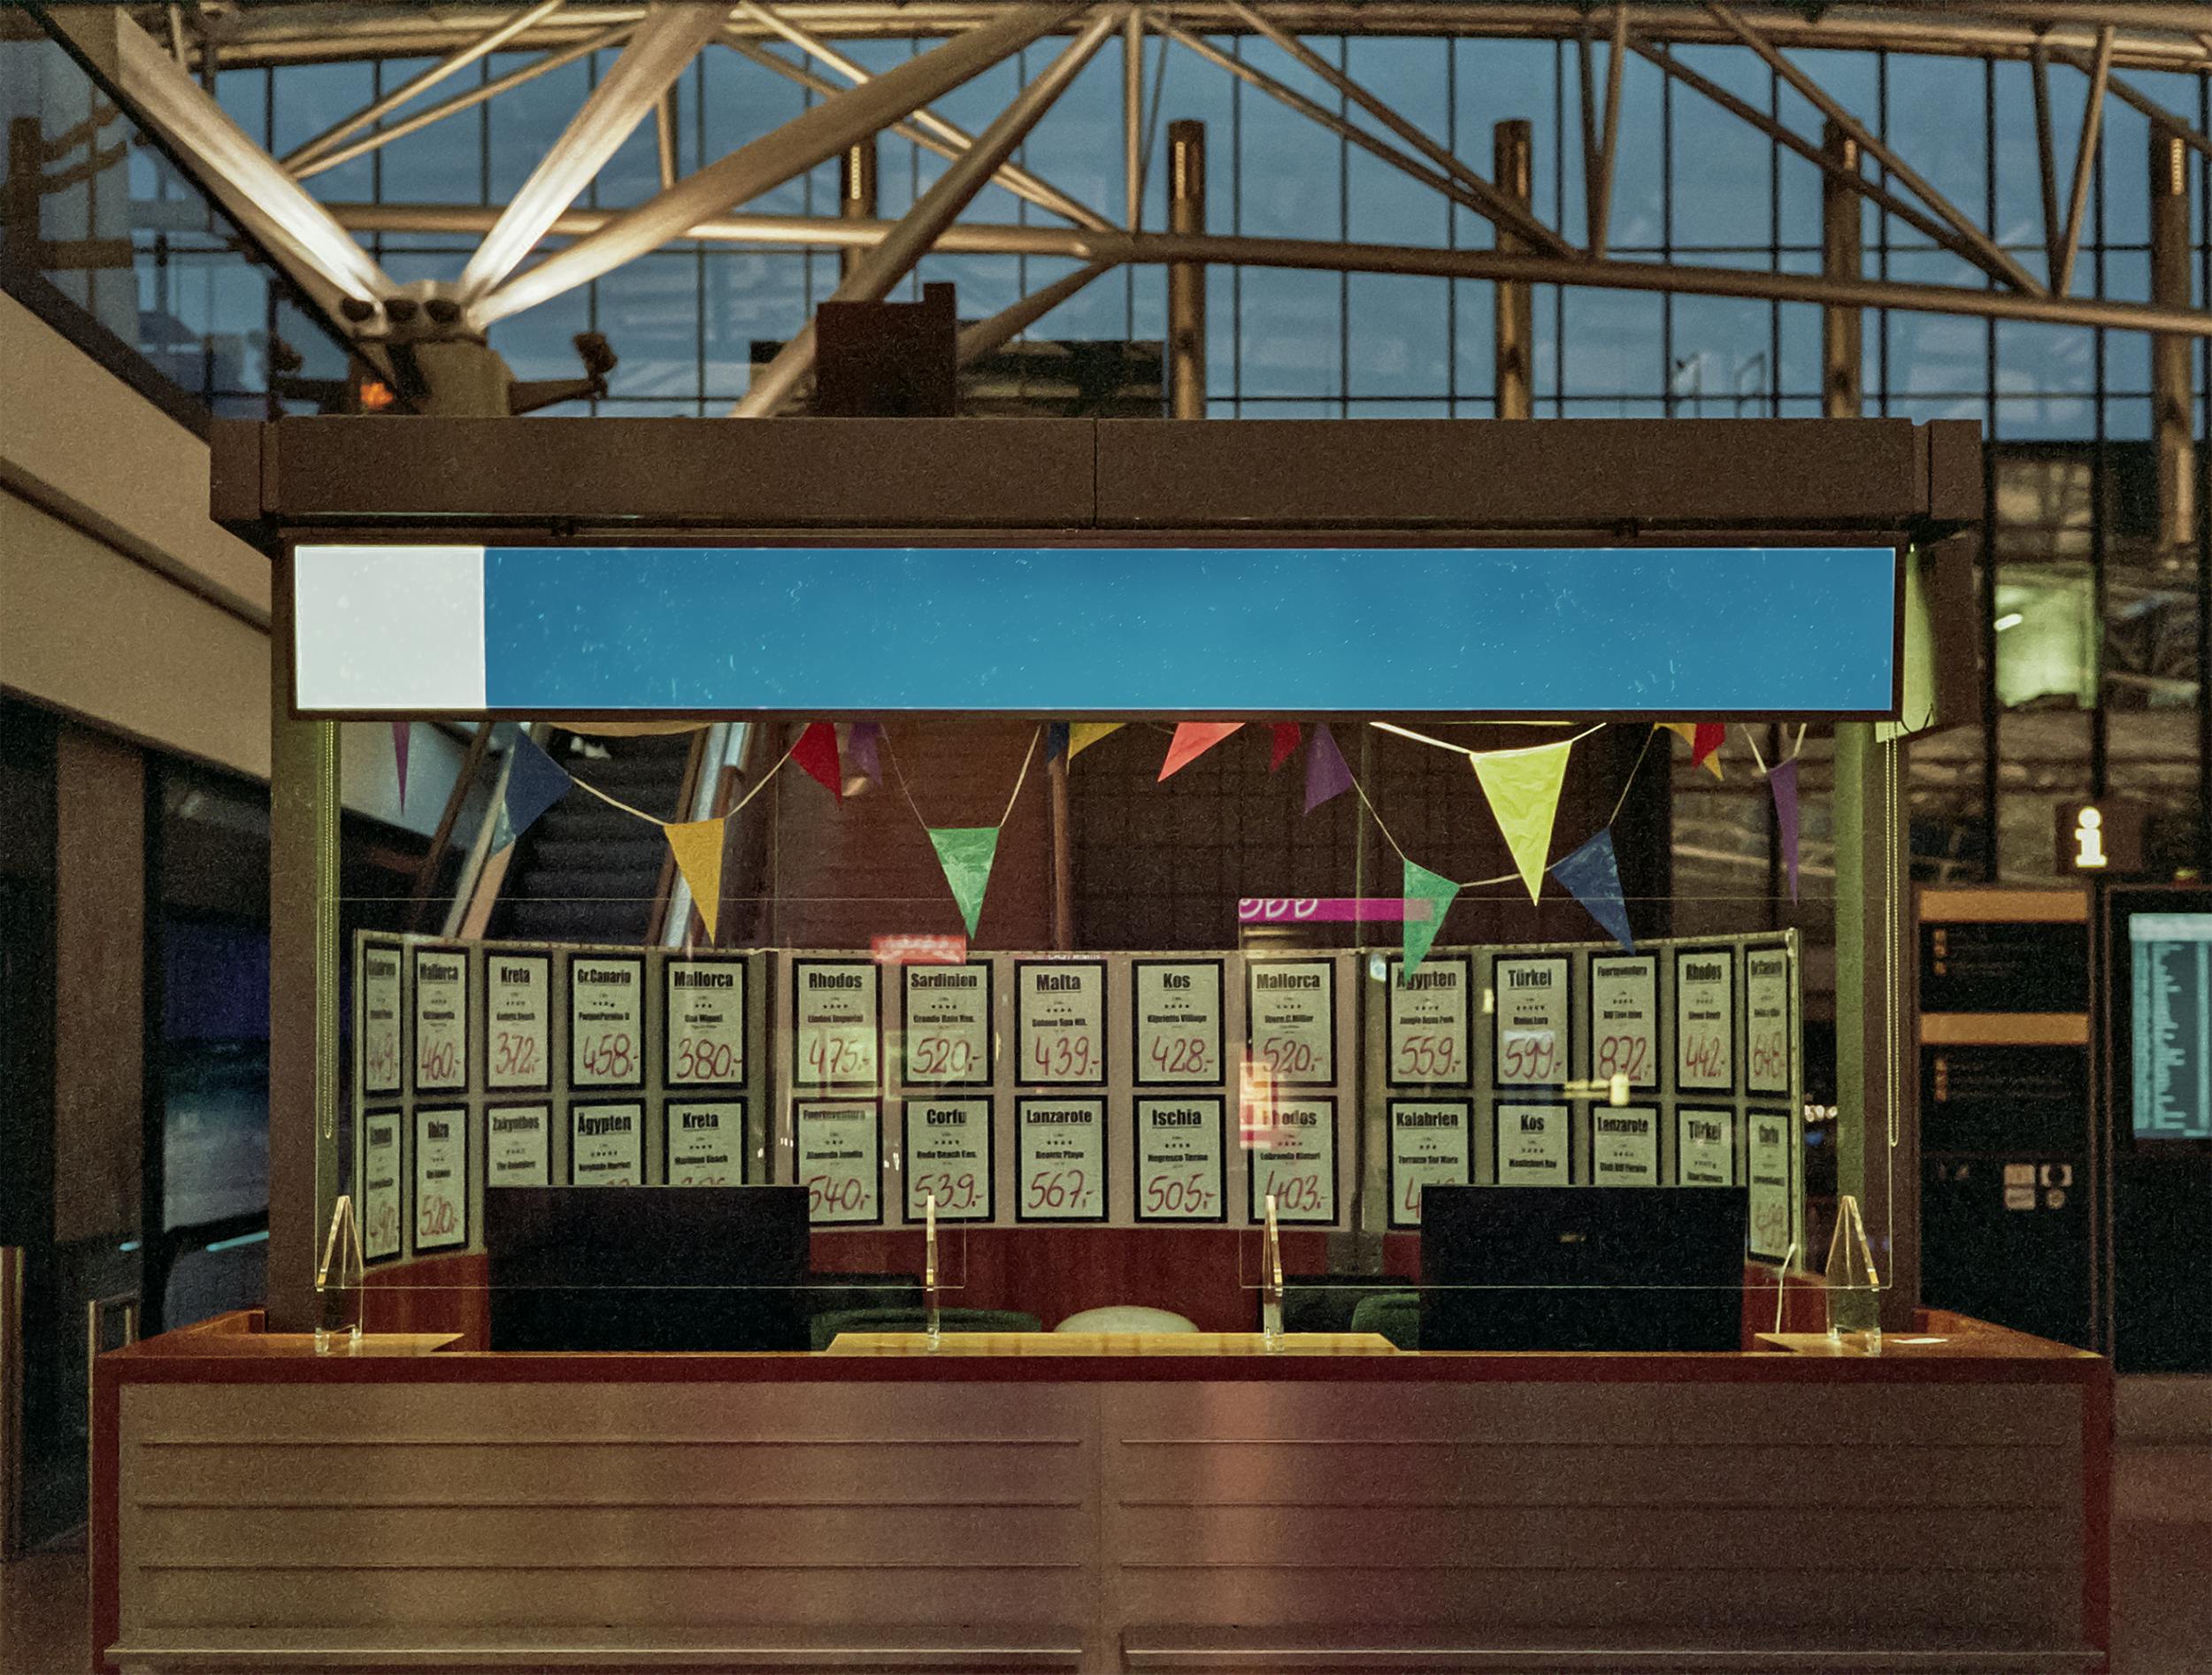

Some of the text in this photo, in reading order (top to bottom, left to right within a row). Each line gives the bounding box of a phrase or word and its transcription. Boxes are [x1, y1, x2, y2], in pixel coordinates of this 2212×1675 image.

[501, 966, 530, 983] Kreta
[674, 971, 733, 987] Mallorca
[810, 972, 863, 988] Rhodos
[911, 973, 978, 987] Sardinien
[1036, 974, 1081, 991] Malta
[1164, 972, 1191, 988] Kos
[1256, 974, 1320, 988] Mallorca
[1508, 969, 1551, 987] Türkei
[578, 1112, 632, 1135] Ägypten
[682, 1112, 718, 1128] Kreta
[926, 1109, 967, 1125] Corfu
[1026, 1109, 1093, 1125] Lanzarote
[1152, 1109, 1202, 1126] Ischia
[1520, 1114, 1545, 1131] Kos
[1597, 1117, 1648, 1133] Lanzarote
